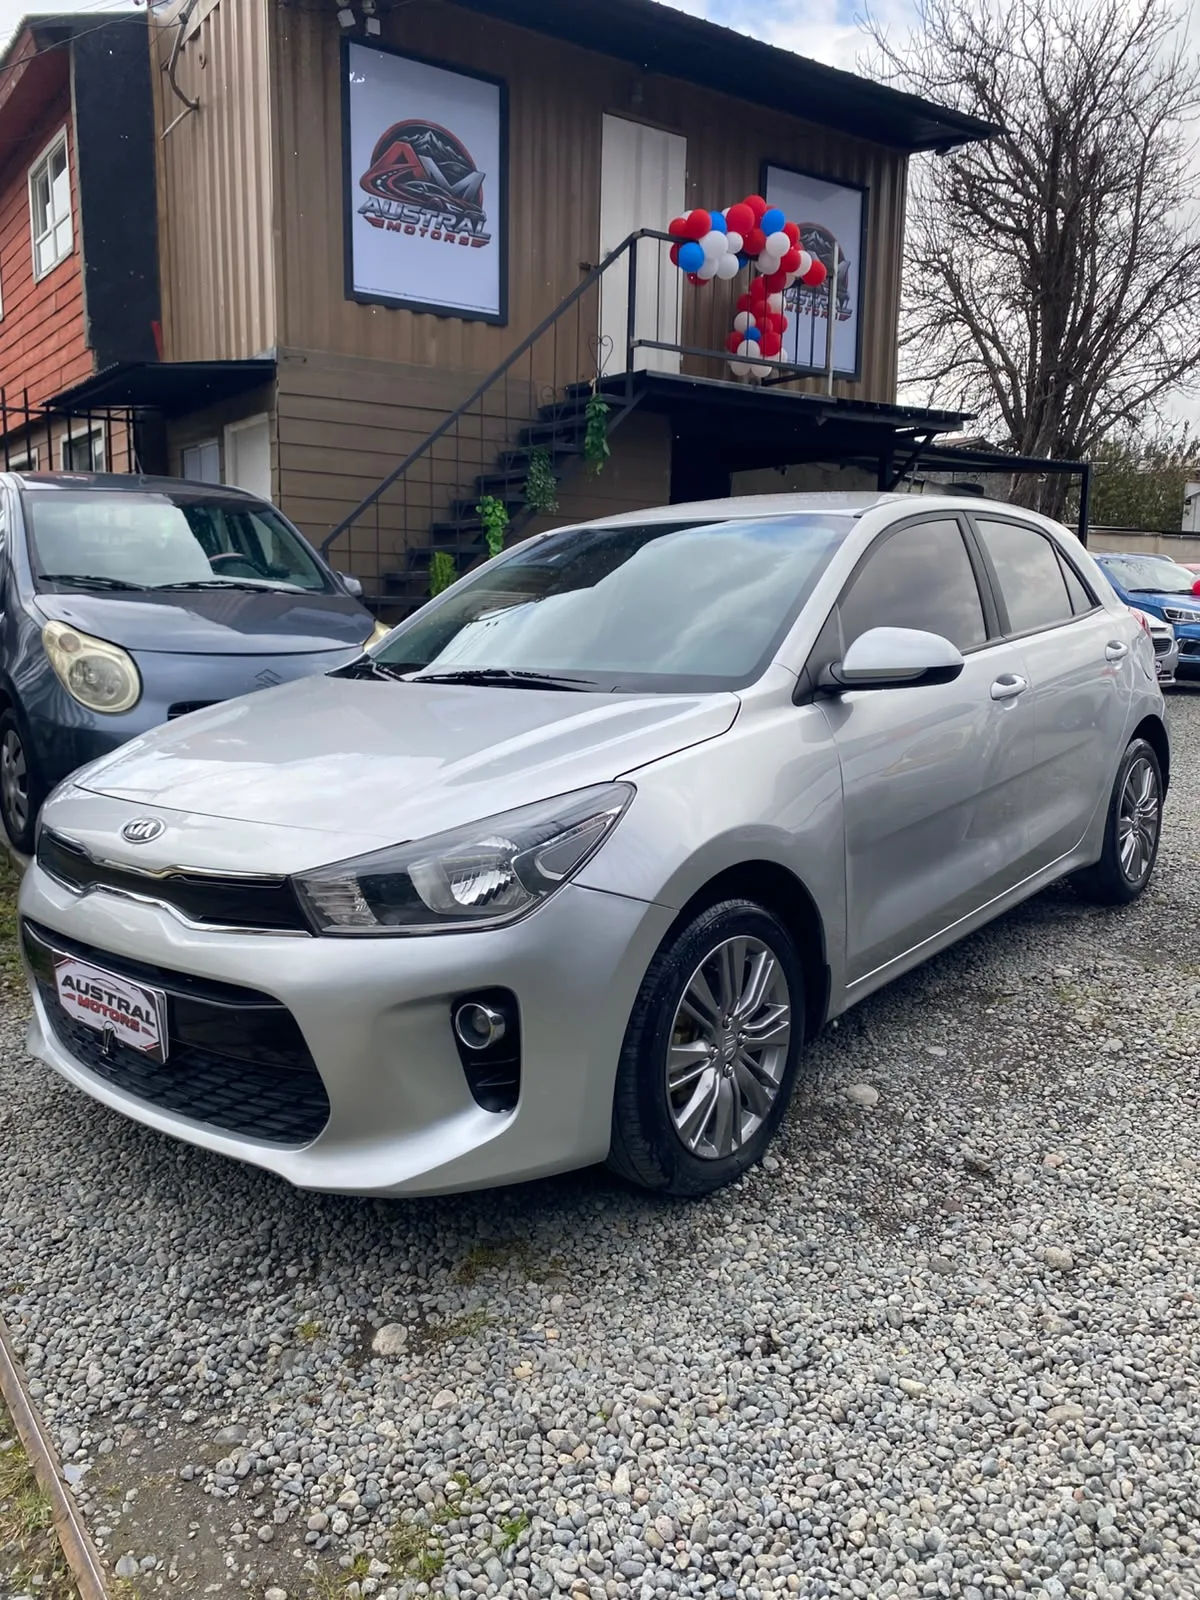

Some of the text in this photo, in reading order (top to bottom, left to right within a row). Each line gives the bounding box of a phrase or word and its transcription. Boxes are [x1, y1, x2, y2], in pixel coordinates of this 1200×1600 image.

[357, 196, 491, 240] AUSTRAL
[386, 220, 470, 246] MOTORS
[784, 286, 853, 315] USTRL
[784, 303, 838, 321] MOTOR
[61, 974, 156, 1028] AUSTRAL
[77, 993, 141, 1033] MOTORS
